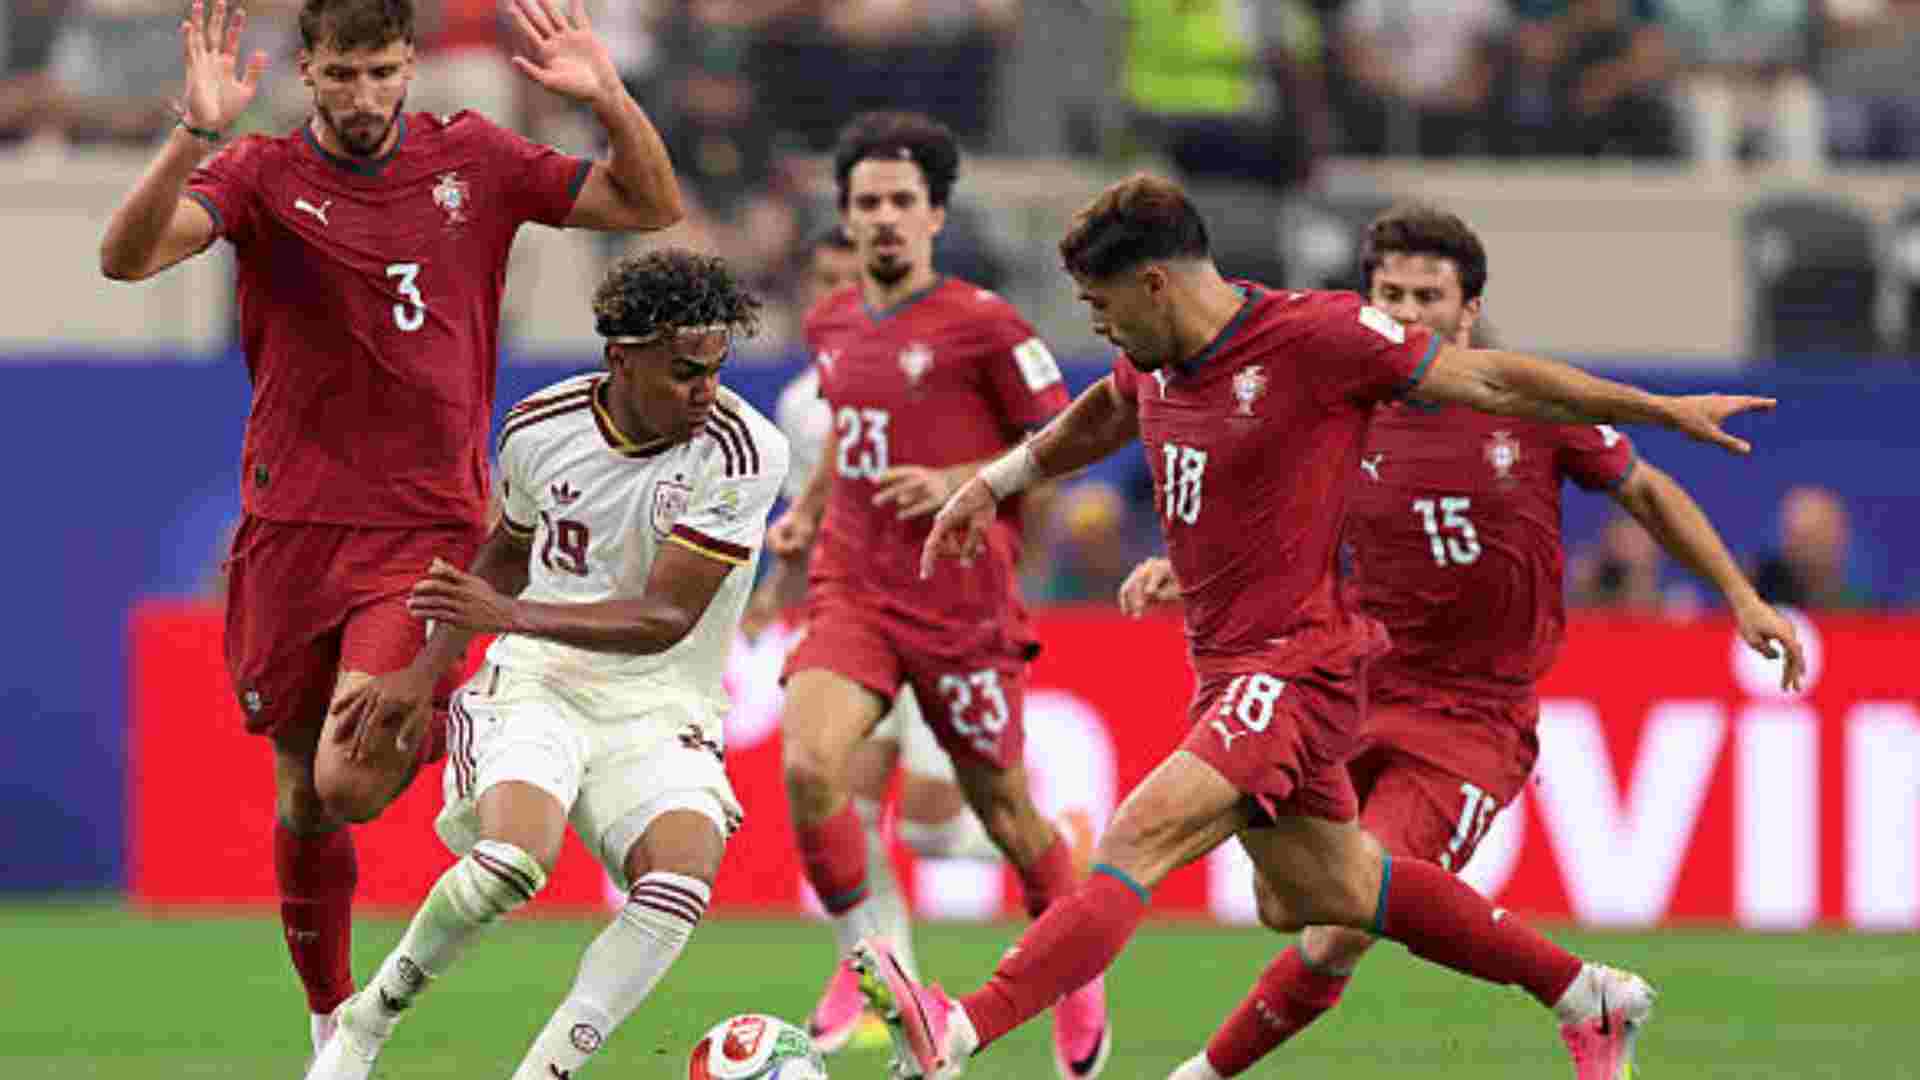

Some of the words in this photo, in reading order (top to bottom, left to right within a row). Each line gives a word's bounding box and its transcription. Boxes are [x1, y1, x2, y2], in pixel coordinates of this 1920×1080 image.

[385, 262, 425, 332] 3
[836, 406, 892, 480] 23
[1163, 442, 1209, 526] 18
[539, 509, 590, 578] 19
[1412, 496, 1482, 568] 15
[938, 668, 1010, 736] 23
[1217, 673, 1287, 733] 18
